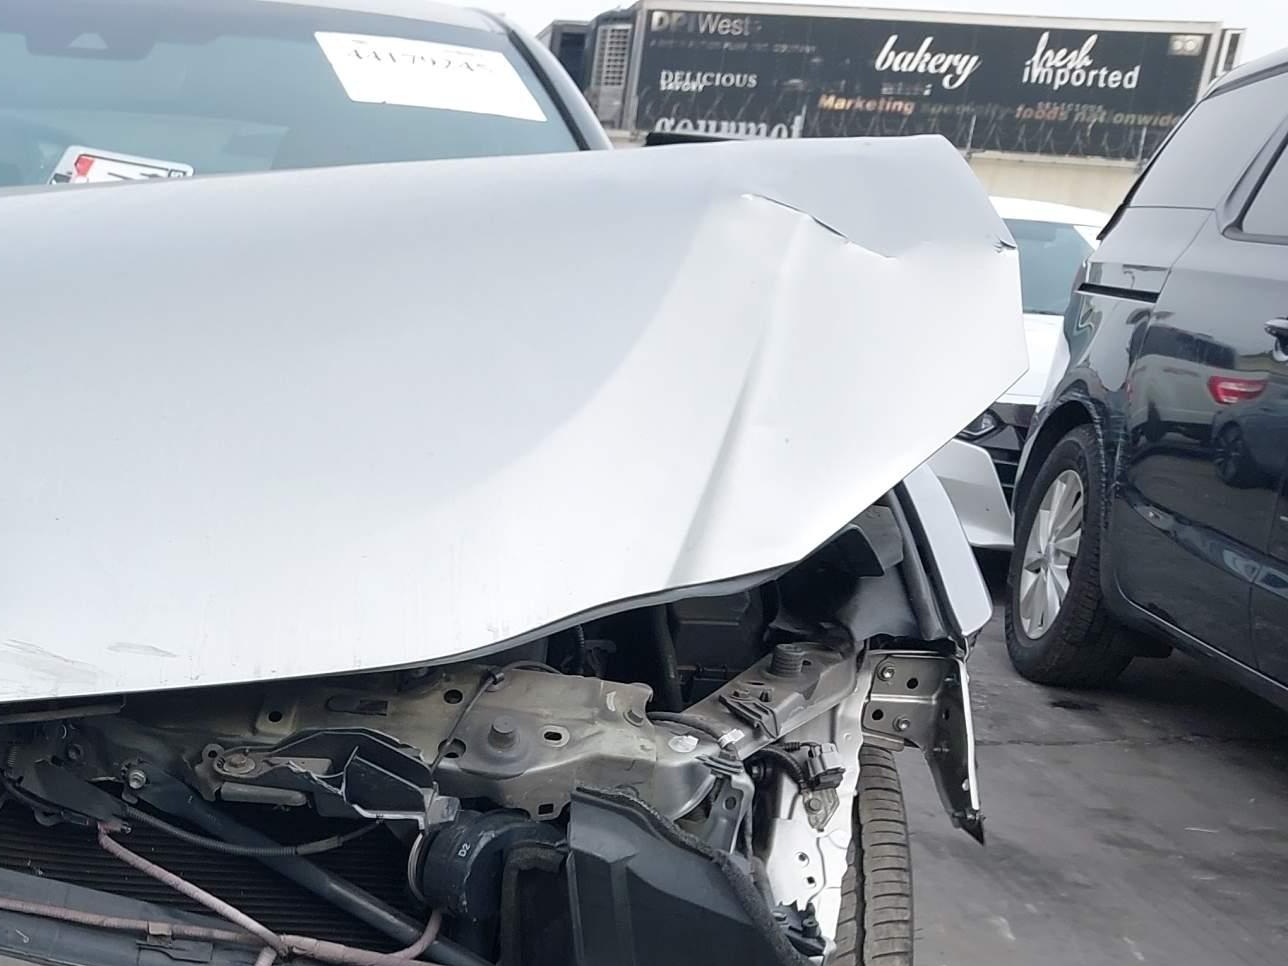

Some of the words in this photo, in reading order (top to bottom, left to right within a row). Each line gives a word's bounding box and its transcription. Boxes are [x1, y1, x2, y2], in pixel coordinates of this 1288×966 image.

[697, 13, 751, 37] West
[874, 34, 982, 90] bakery
[1022, 60, 1141, 91] imported
[660, 69, 758, 89] DELICIOUS
[818, 93, 916, 115] Marketing
[1073, 107, 1179, 127] natonwide
[458, 843, 471, 857] D2
